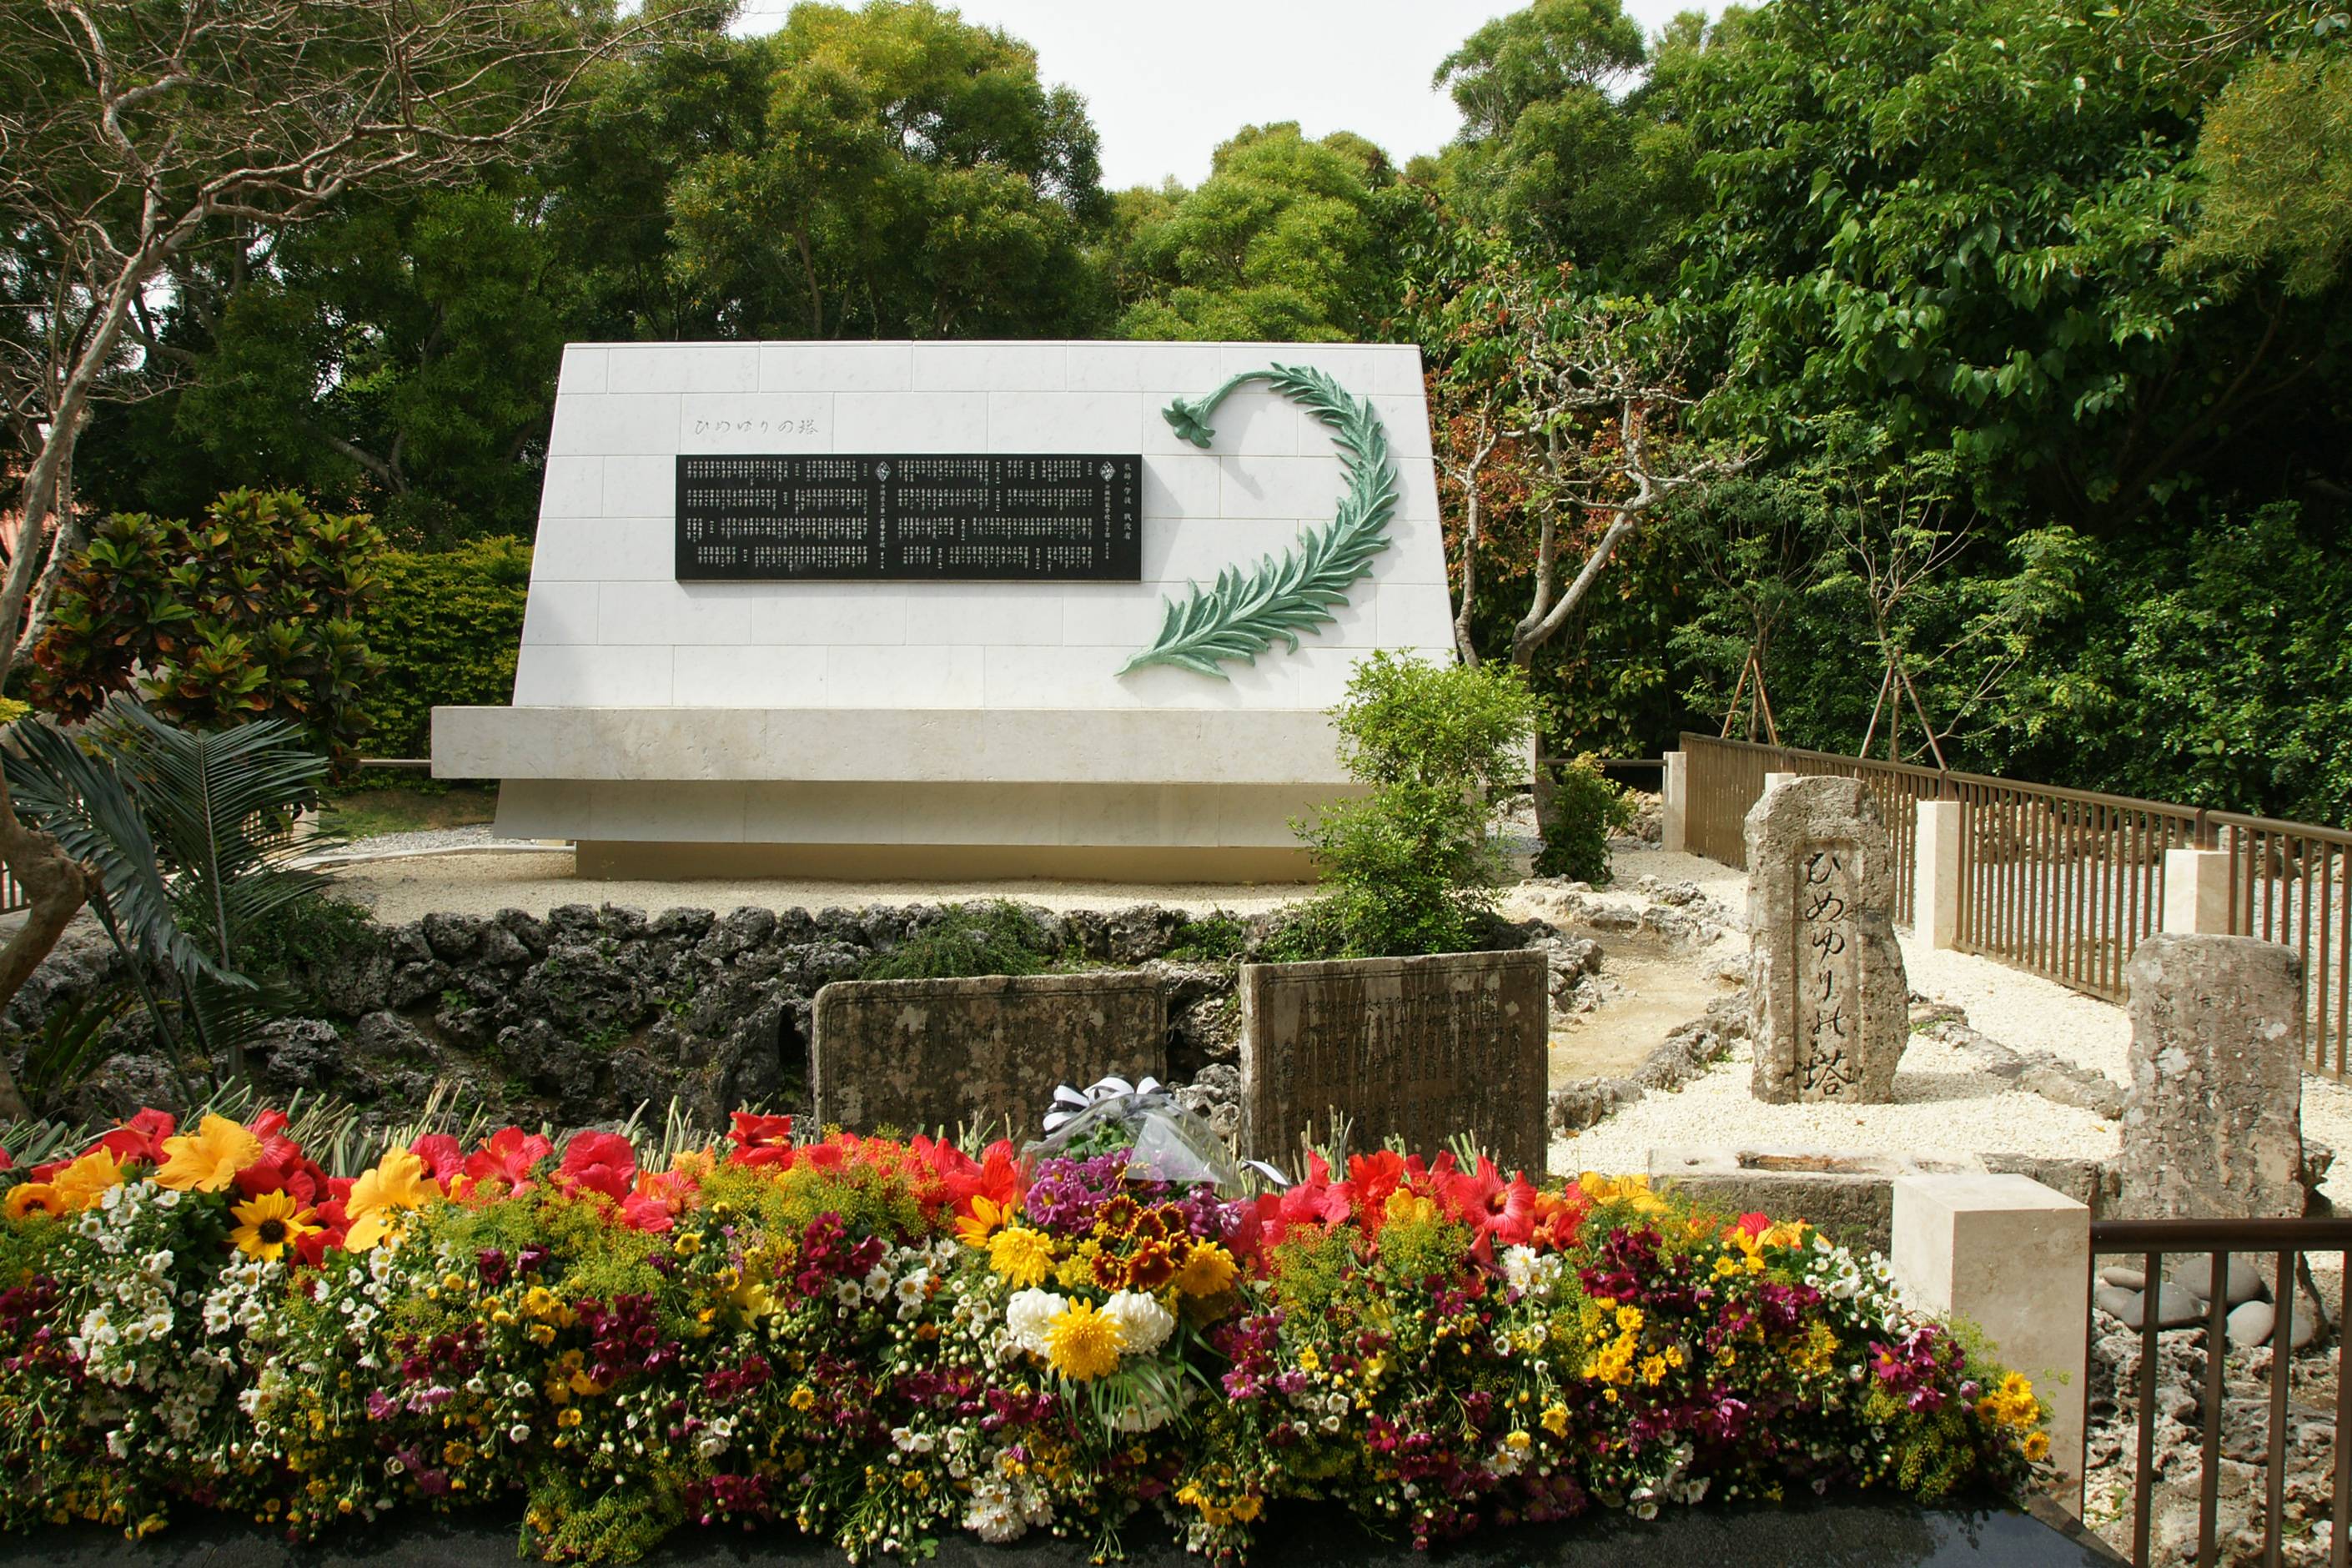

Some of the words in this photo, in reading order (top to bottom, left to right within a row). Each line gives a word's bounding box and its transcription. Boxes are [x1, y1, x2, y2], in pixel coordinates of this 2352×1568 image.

[694, 419, 819, 435] ひめゆりの塔
